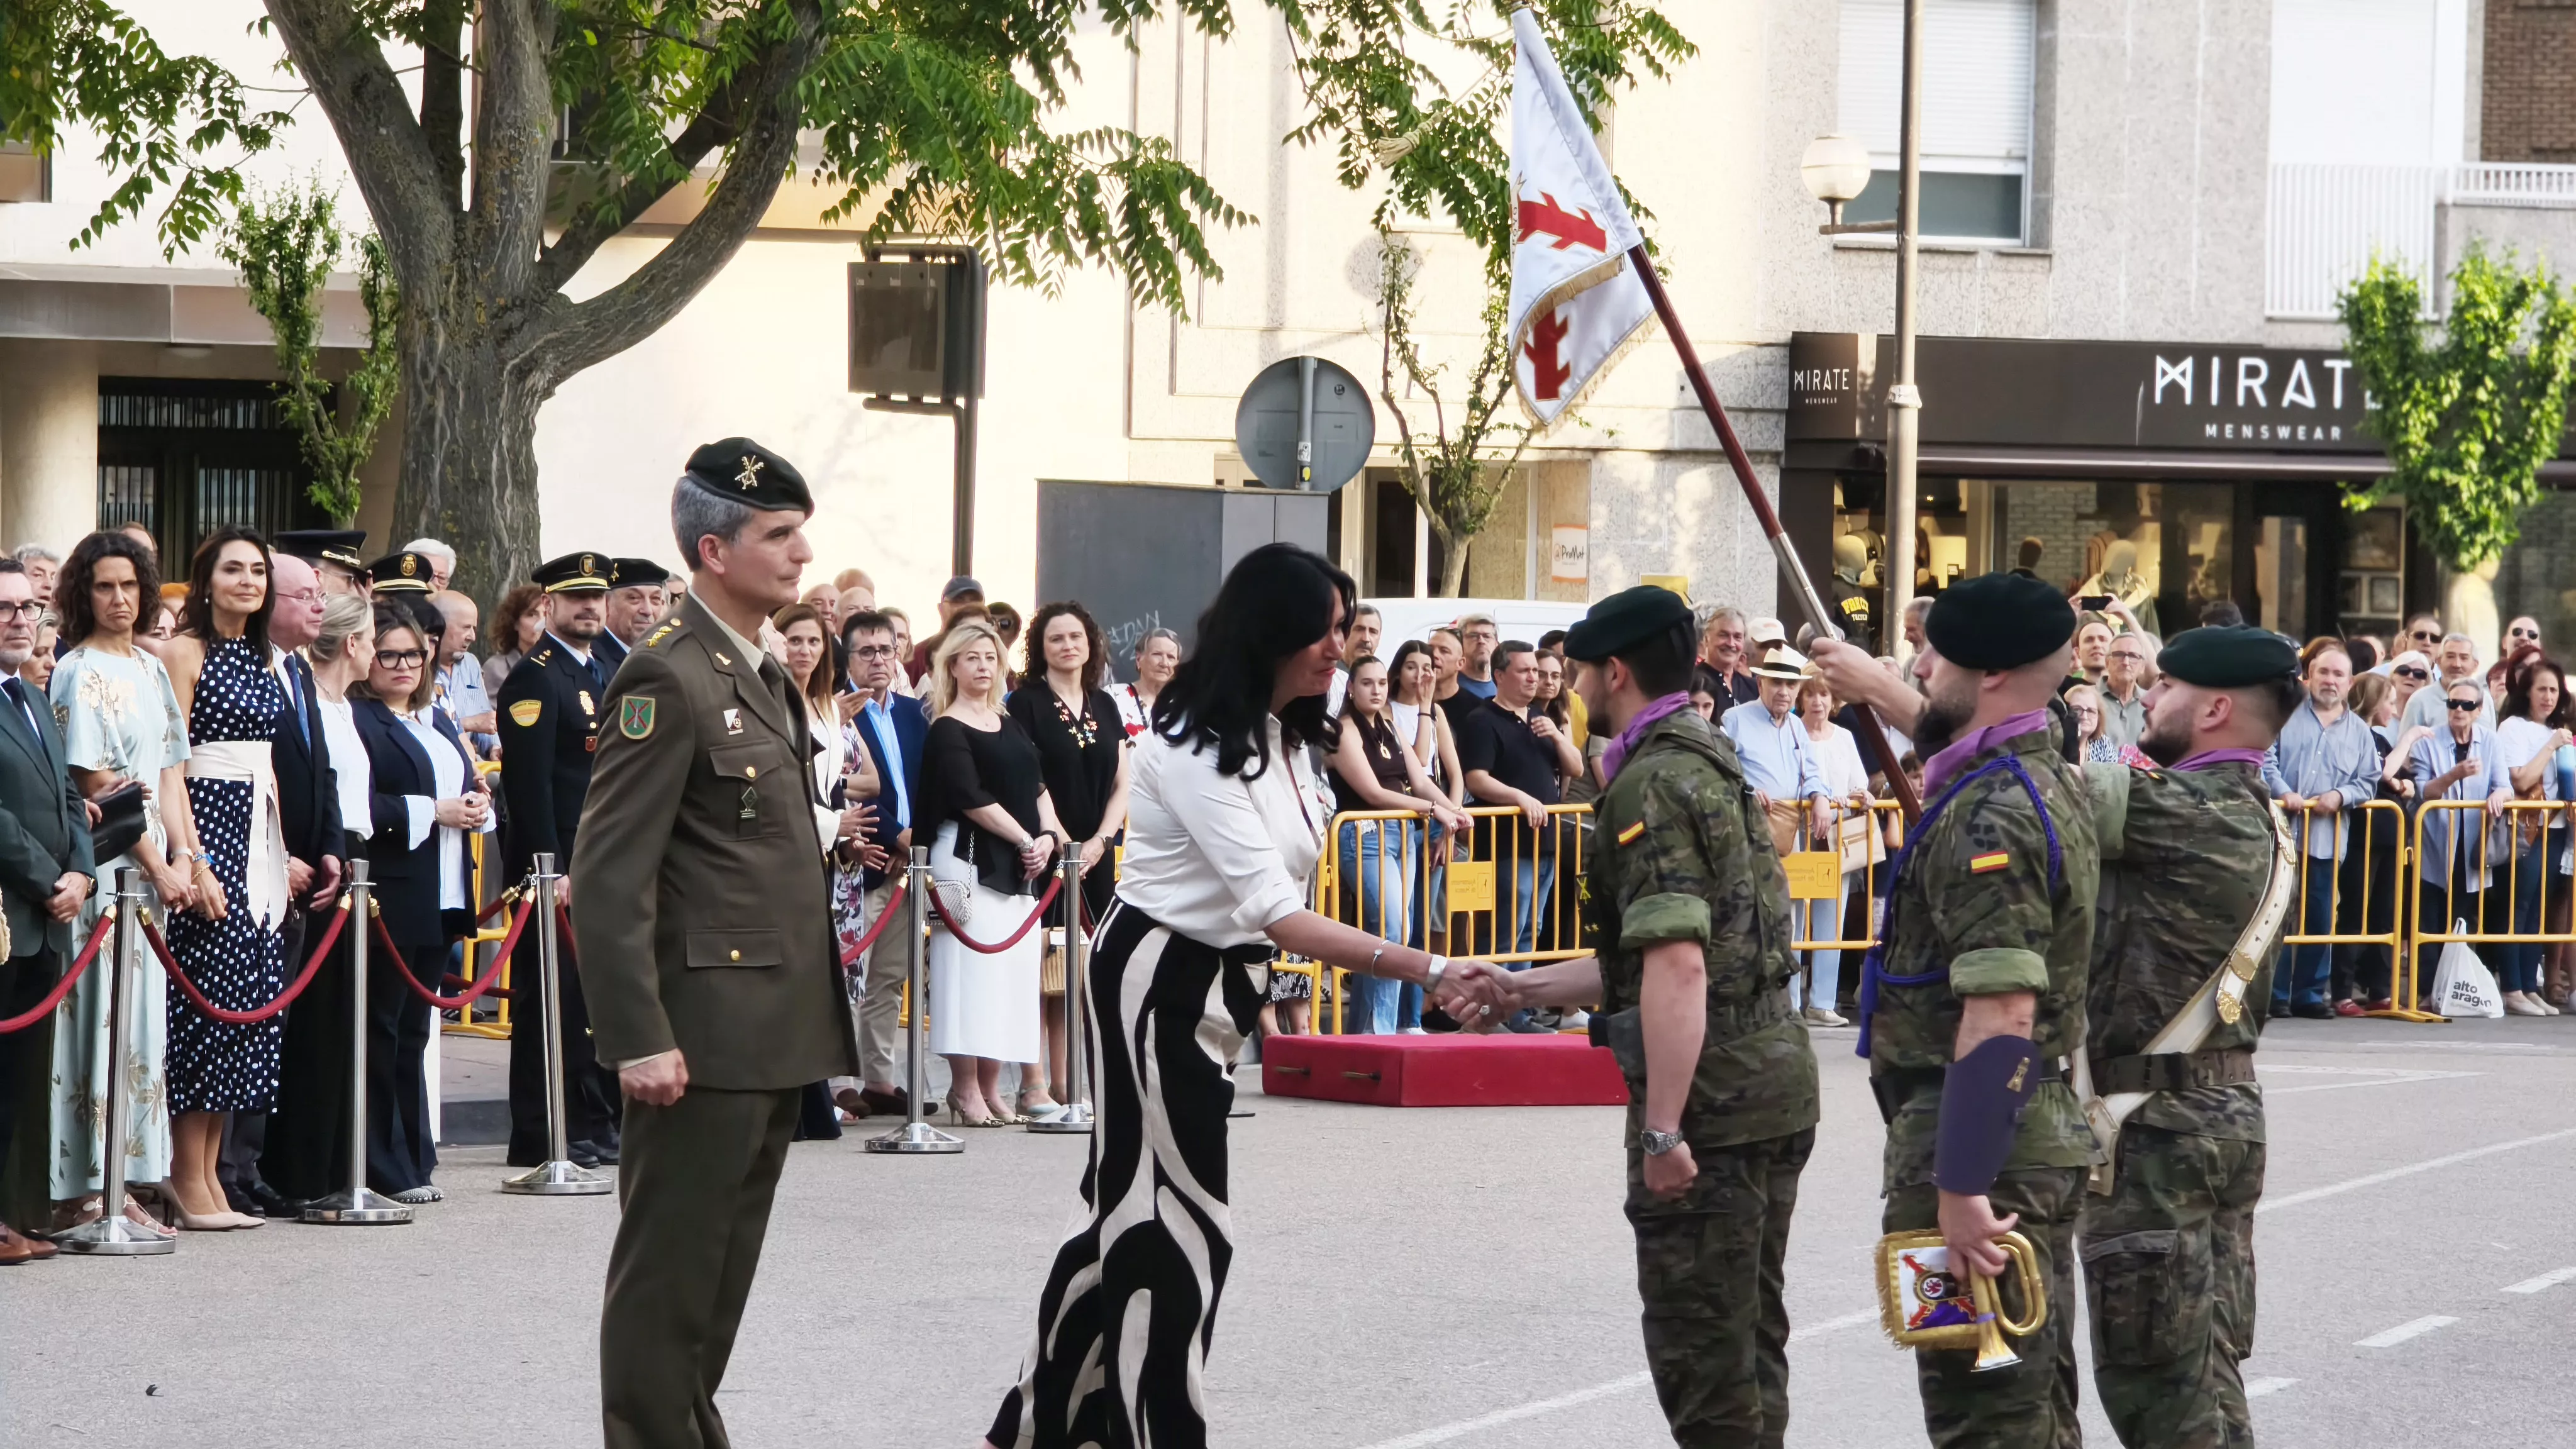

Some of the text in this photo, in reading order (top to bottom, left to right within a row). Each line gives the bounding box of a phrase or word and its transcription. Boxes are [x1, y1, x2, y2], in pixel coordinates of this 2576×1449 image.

[1794, 369, 1850, 391] MIRATE
[2155, 355, 2383, 410] MIRAT
[2206, 424, 2341, 440] MENSWEAR
[2453, 980, 2477, 993] alto
